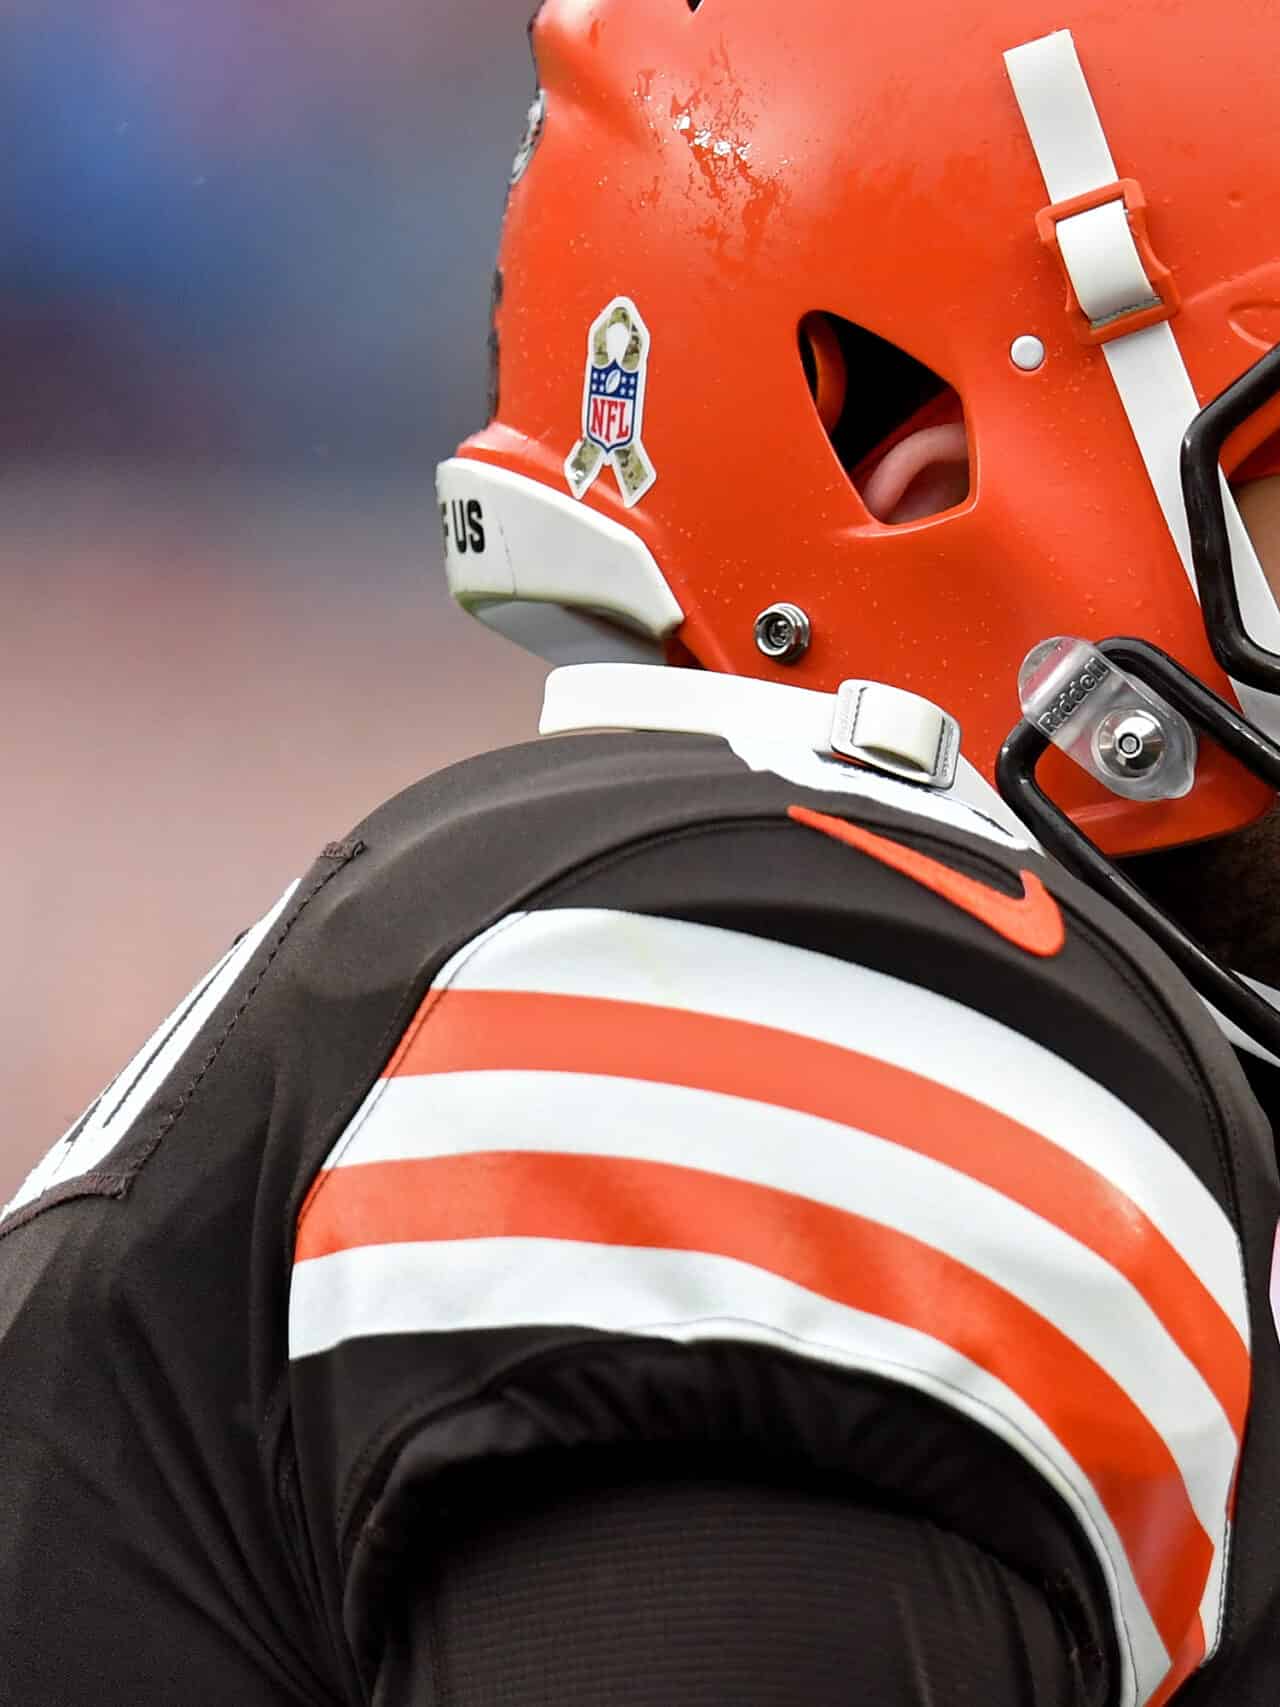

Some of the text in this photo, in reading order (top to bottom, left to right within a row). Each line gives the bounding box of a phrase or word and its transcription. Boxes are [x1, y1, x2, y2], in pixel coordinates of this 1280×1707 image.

[591, 397, 629, 442] NFL
[451, 498, 486, 554] US
[1037, 656, 1110, 736] Riddell
